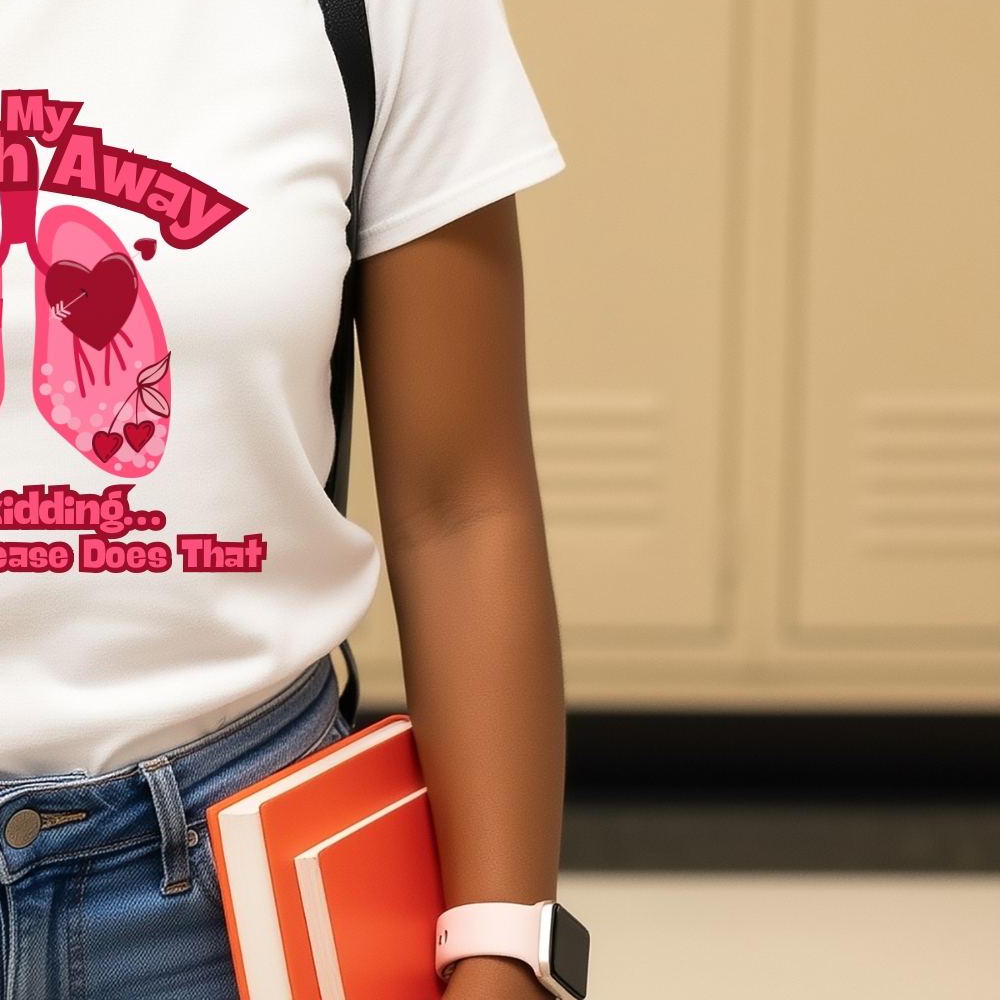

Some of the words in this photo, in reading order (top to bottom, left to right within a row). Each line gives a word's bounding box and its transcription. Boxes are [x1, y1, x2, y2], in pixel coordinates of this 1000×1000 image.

[3, 92, 77, 144] My
[49, 132, 235, 243] Away
[81, 537, 170, 570] Does
[180, 537, 264, 570] That
